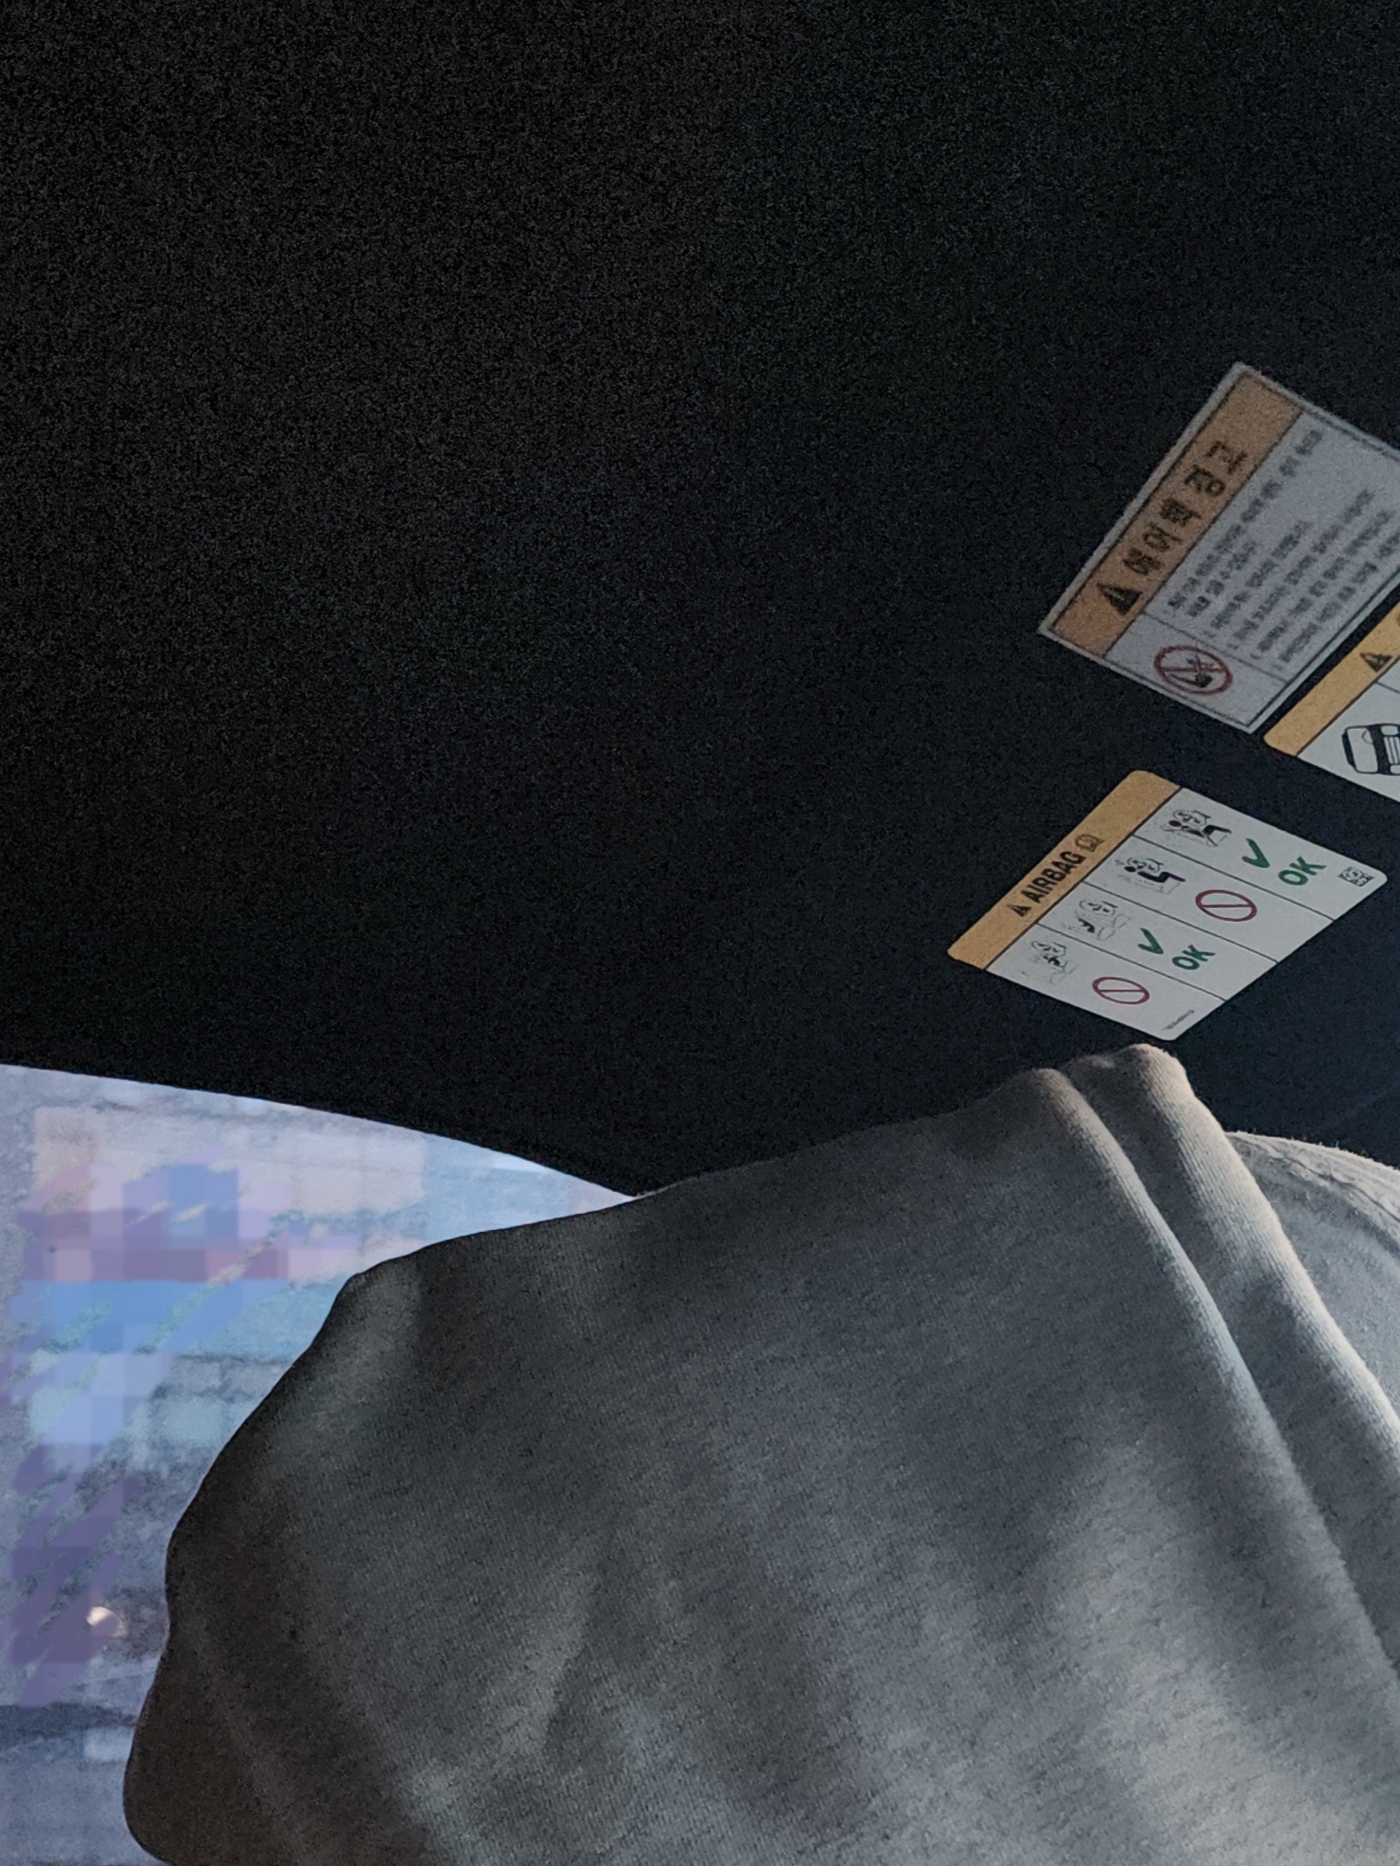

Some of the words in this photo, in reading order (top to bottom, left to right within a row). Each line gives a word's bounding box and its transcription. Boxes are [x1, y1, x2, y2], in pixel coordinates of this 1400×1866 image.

[1122, 500, 1201, 576] 에어백
[1184, 440, 1247, 497] 경고
[1020, 850, 1086, 904] AIRBAG
[1278, 856, 1327, 886] OK
[1172, 944, 1216, 970] OK
